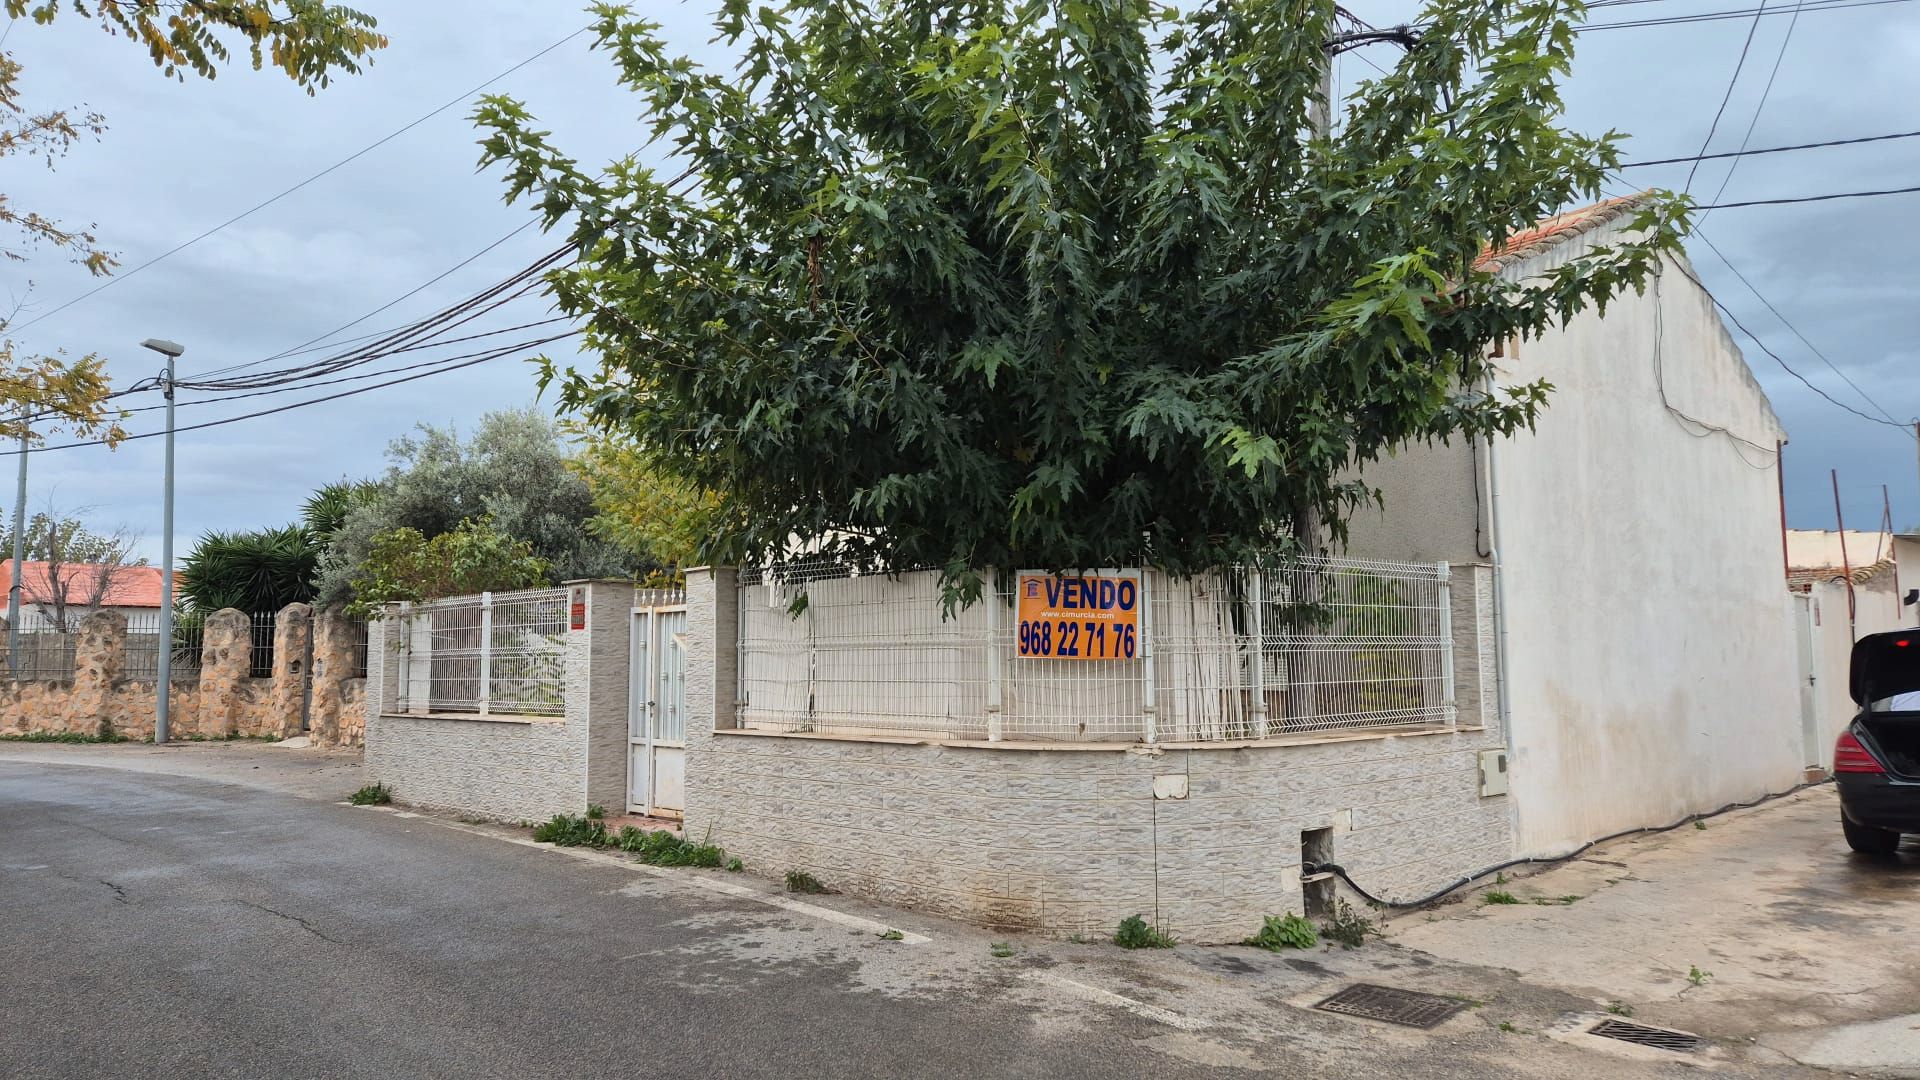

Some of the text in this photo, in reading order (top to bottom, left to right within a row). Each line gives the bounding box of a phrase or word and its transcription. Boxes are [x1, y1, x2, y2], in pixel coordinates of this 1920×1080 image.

[1045, 578, 1136, 610] VENDO
[1041, 611, 1115, 619] www.cimurcia.com
[1020, 620, 1135, 658] 968 22 71 76
